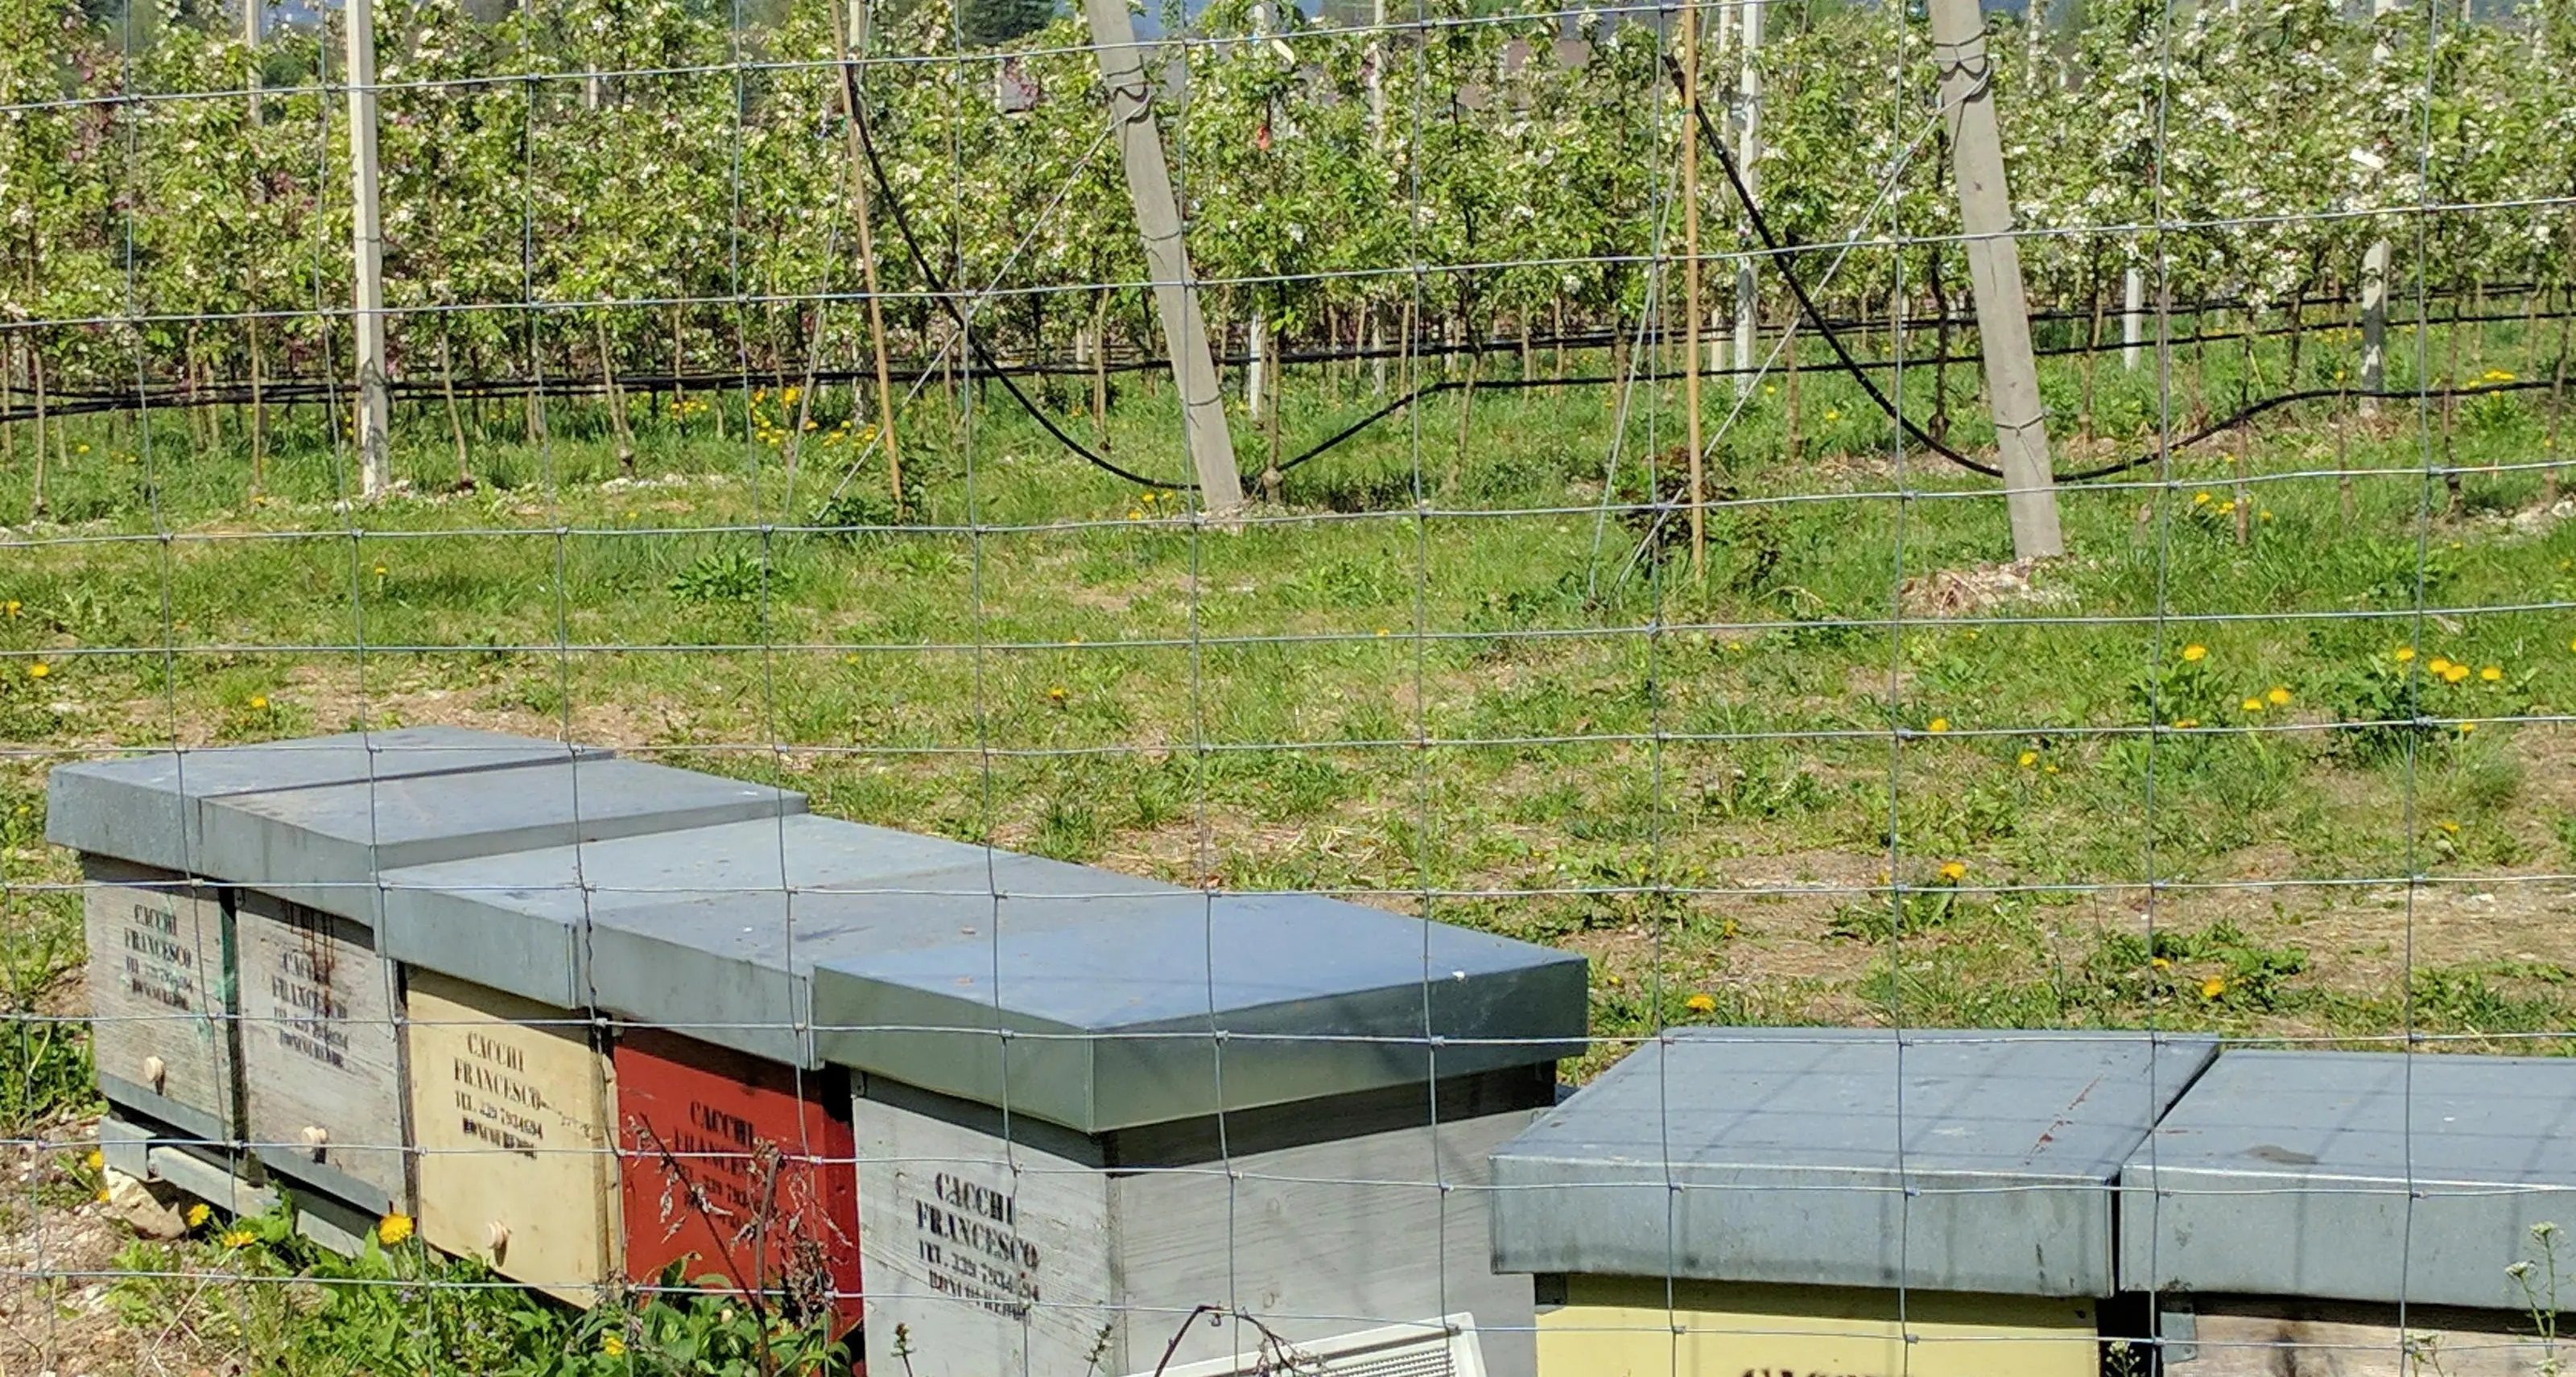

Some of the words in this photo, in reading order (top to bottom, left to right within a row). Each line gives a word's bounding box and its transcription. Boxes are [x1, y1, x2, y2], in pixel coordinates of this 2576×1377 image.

[467, 1030, 524, 1073] CACCHI
[454, 1057, 541, 1111] FRANCESCO
[690, 1100, 754, 1148] CACCHI
[935, 1172, 1014, 1227] CACCHI
[915, 1198, 1041, 1273] FRANCESCO
[980, 1262, 1039, 1304] 793494
